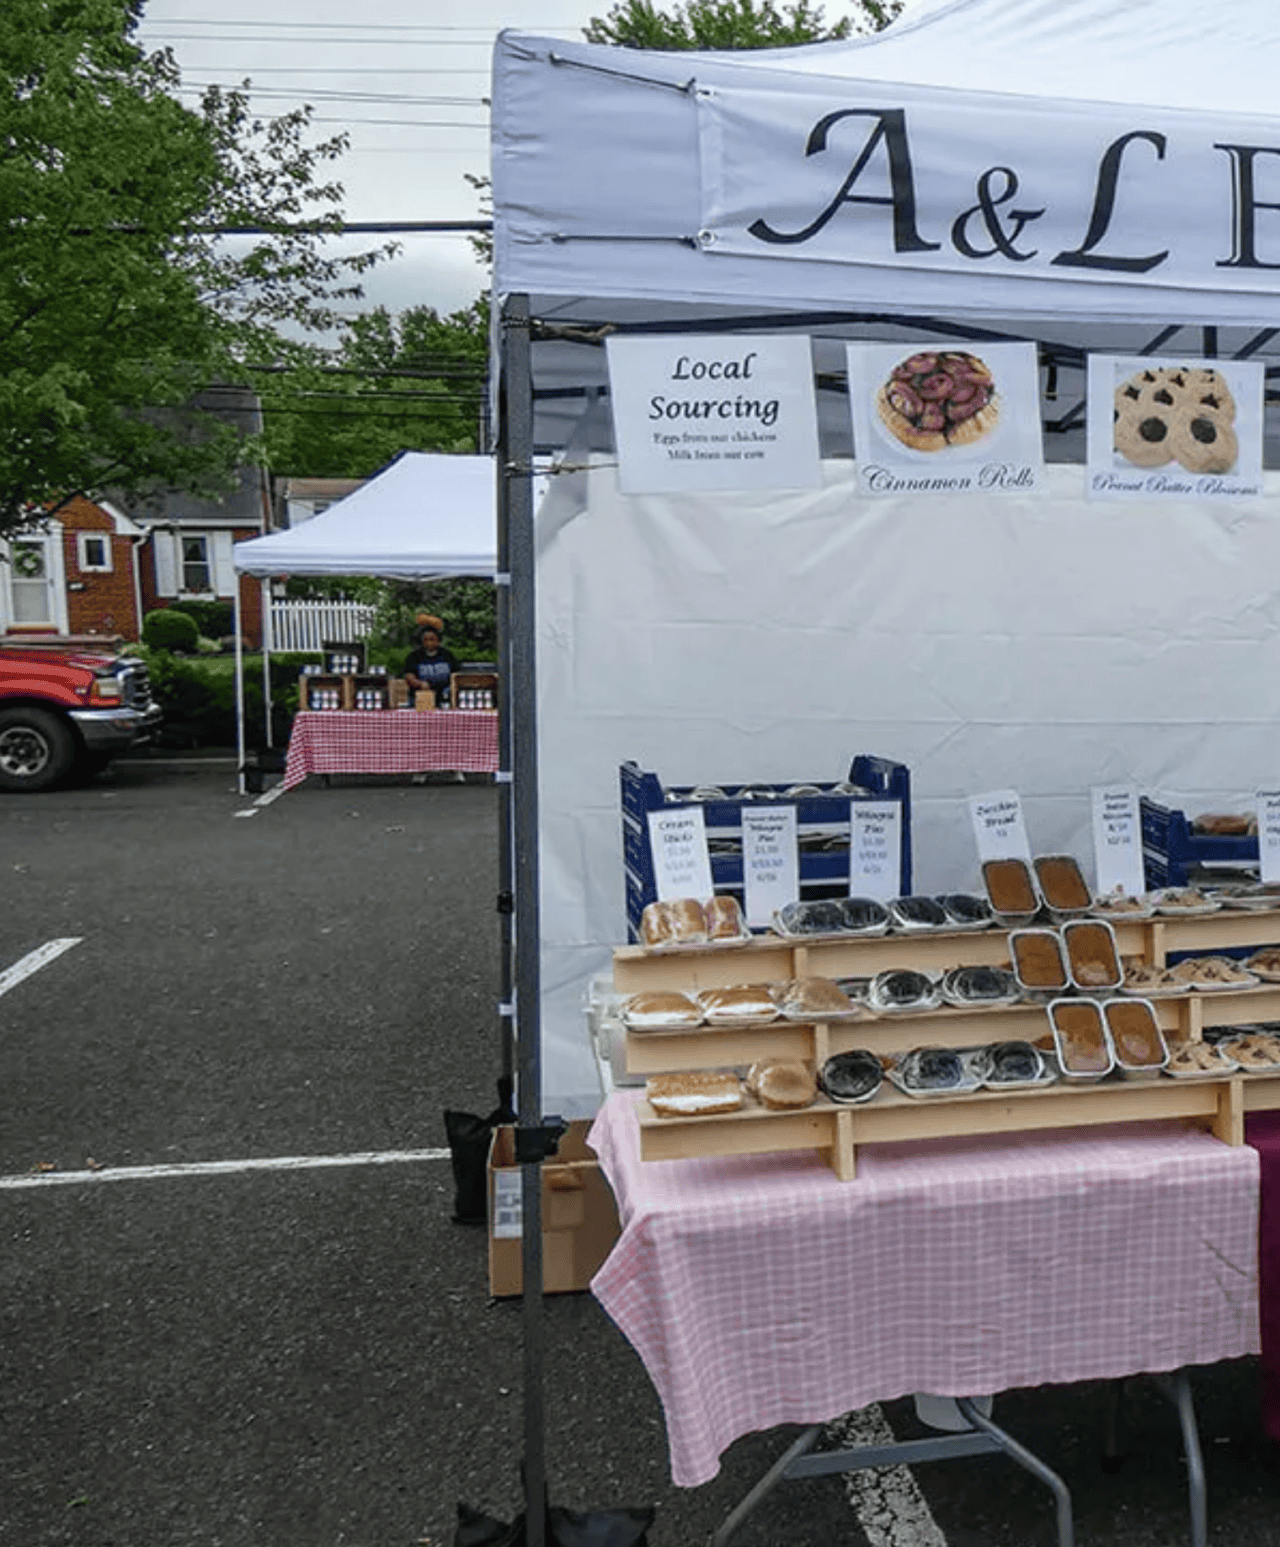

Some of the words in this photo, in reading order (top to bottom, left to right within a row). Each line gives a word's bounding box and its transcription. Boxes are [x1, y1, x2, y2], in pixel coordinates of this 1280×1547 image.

[747, 108, 1170, 273] A&L
[672, 353, 757, 380] Local
[649, 396, 779, 426] Sourcing
[653, 433, 680, 444] Eggs
[682, 431, 708, 443] from
[711, 434, 729, 443] our
[731, 431, 777, 443] chickens
[669, 449, 692, 460] Milk
[694, 449, 720, 460] from
[724, 450, 742, 460] our
[744, 451, 764, 460] cow
[862, 464, 972, 492] Cinnamon
[978, 463, 1035, 488] Rolls
[1092, 474, 1143, 491] Peanut
[1145, 476, 1192, 494] Butter
[1197, 477, 1258, 496] Blossoms
